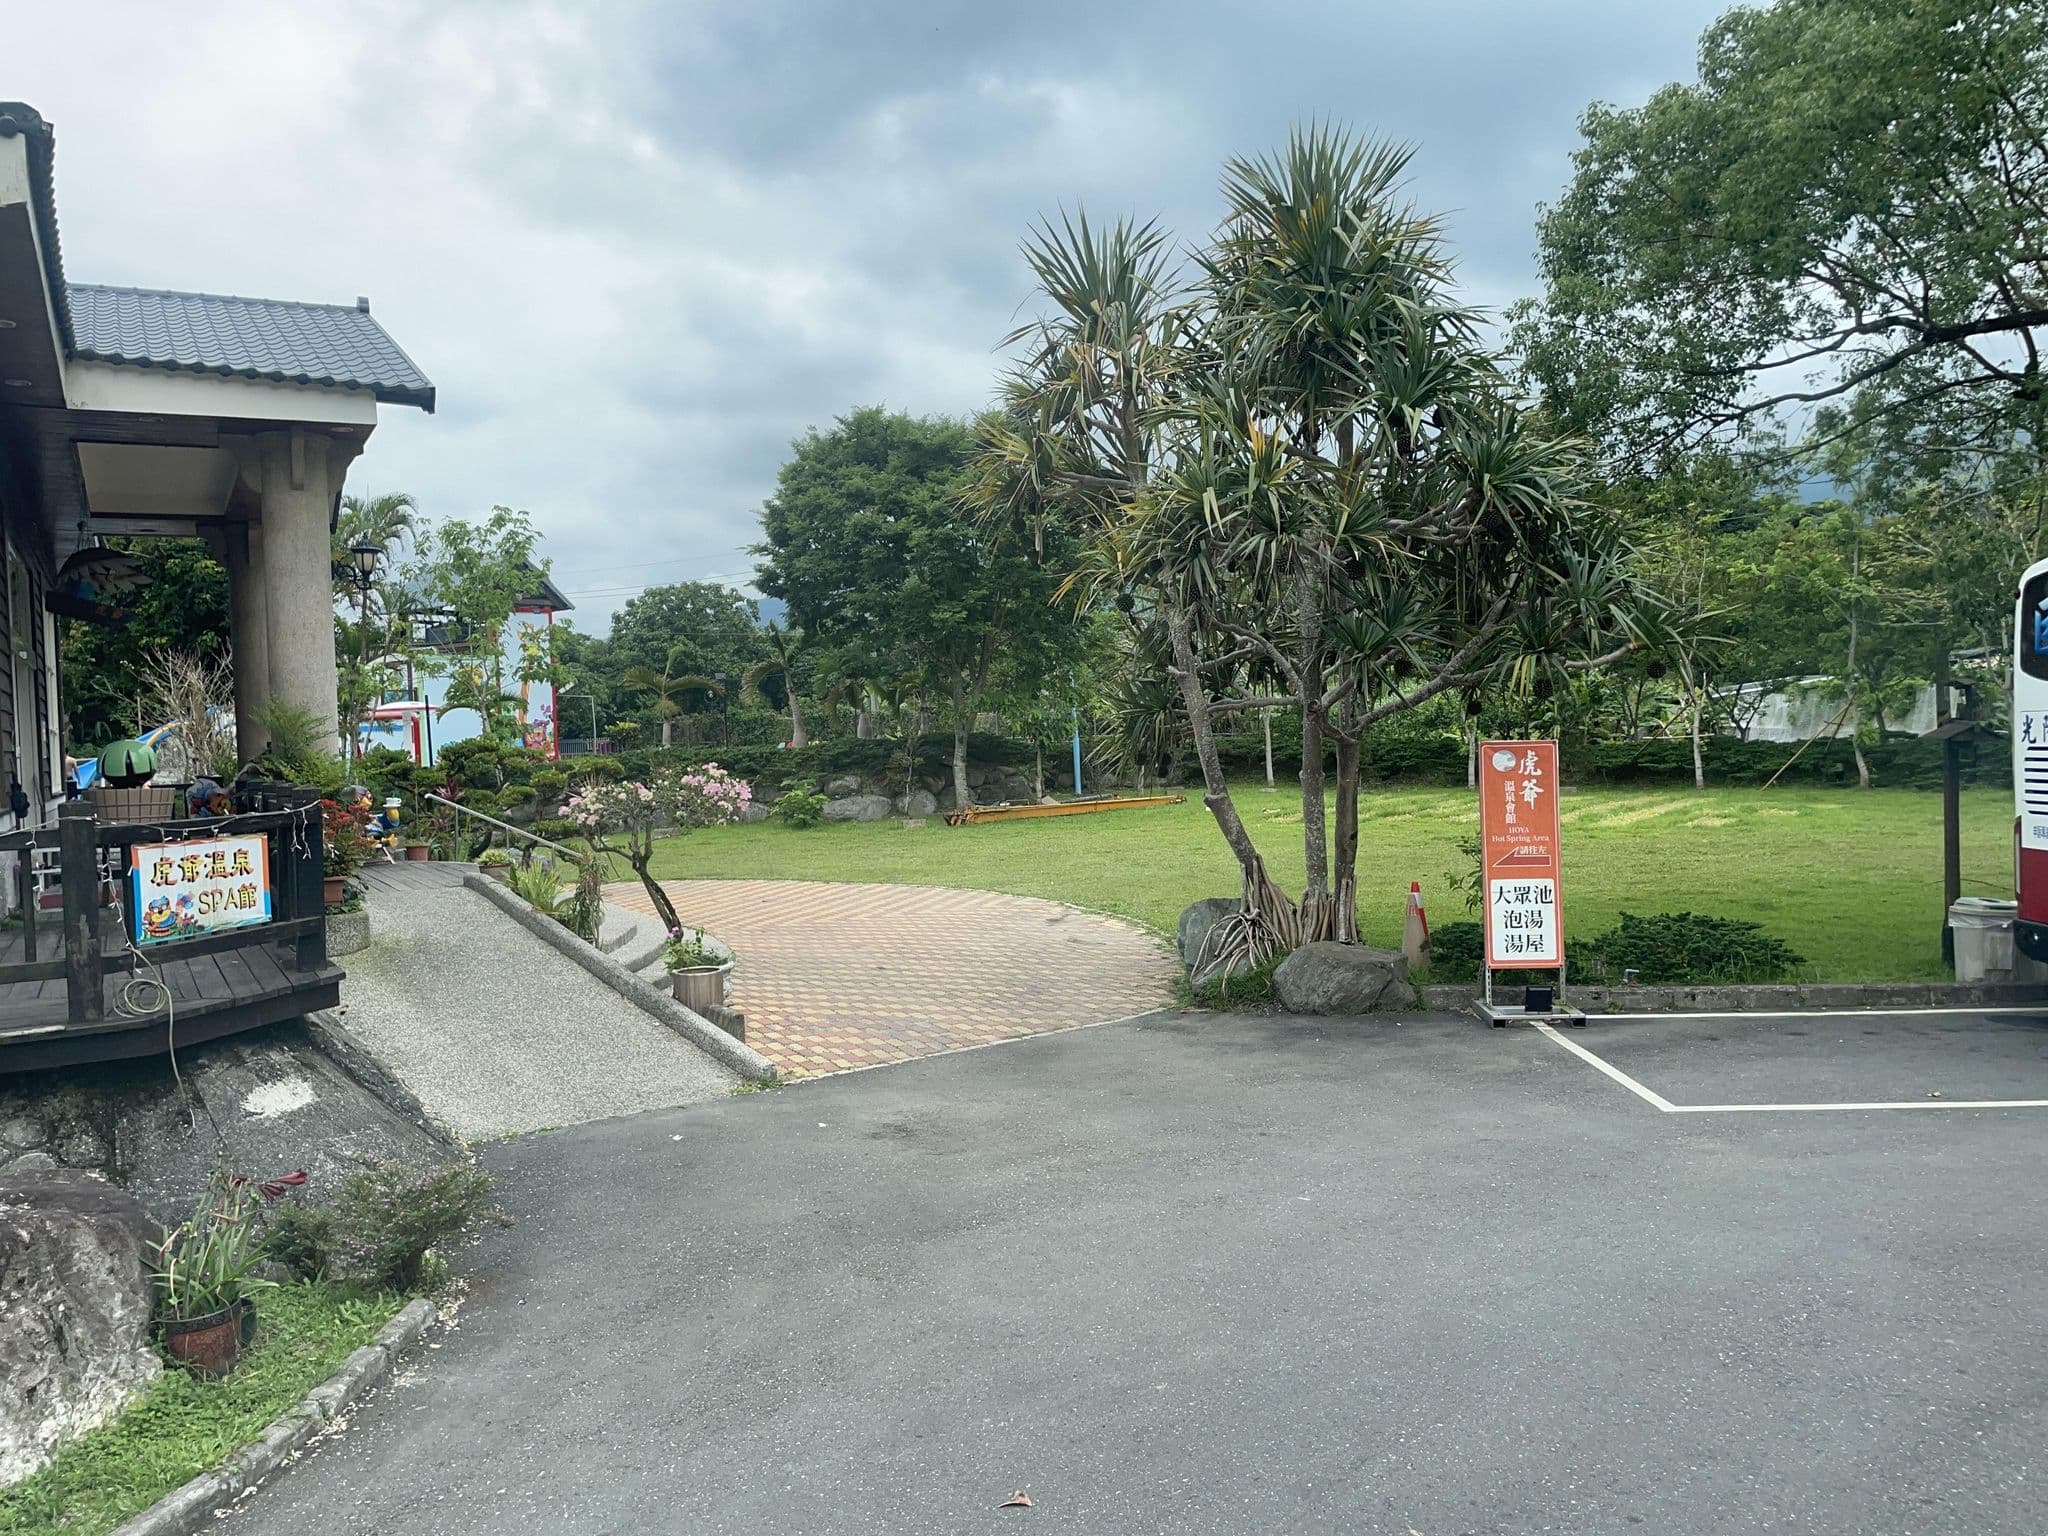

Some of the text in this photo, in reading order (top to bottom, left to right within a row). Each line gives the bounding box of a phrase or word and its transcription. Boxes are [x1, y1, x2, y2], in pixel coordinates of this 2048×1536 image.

[1518, 750, 1544, 810] 虎爺
[1506, 835, 1531, 844] Spring
[1508, 826, 1530, 834] HOYA
[1492, 885, 1553, 905] 大眾池
[1503, 909, 1544, 929] 泡湯
[1504, 934, 1545, 953] 湯屋
